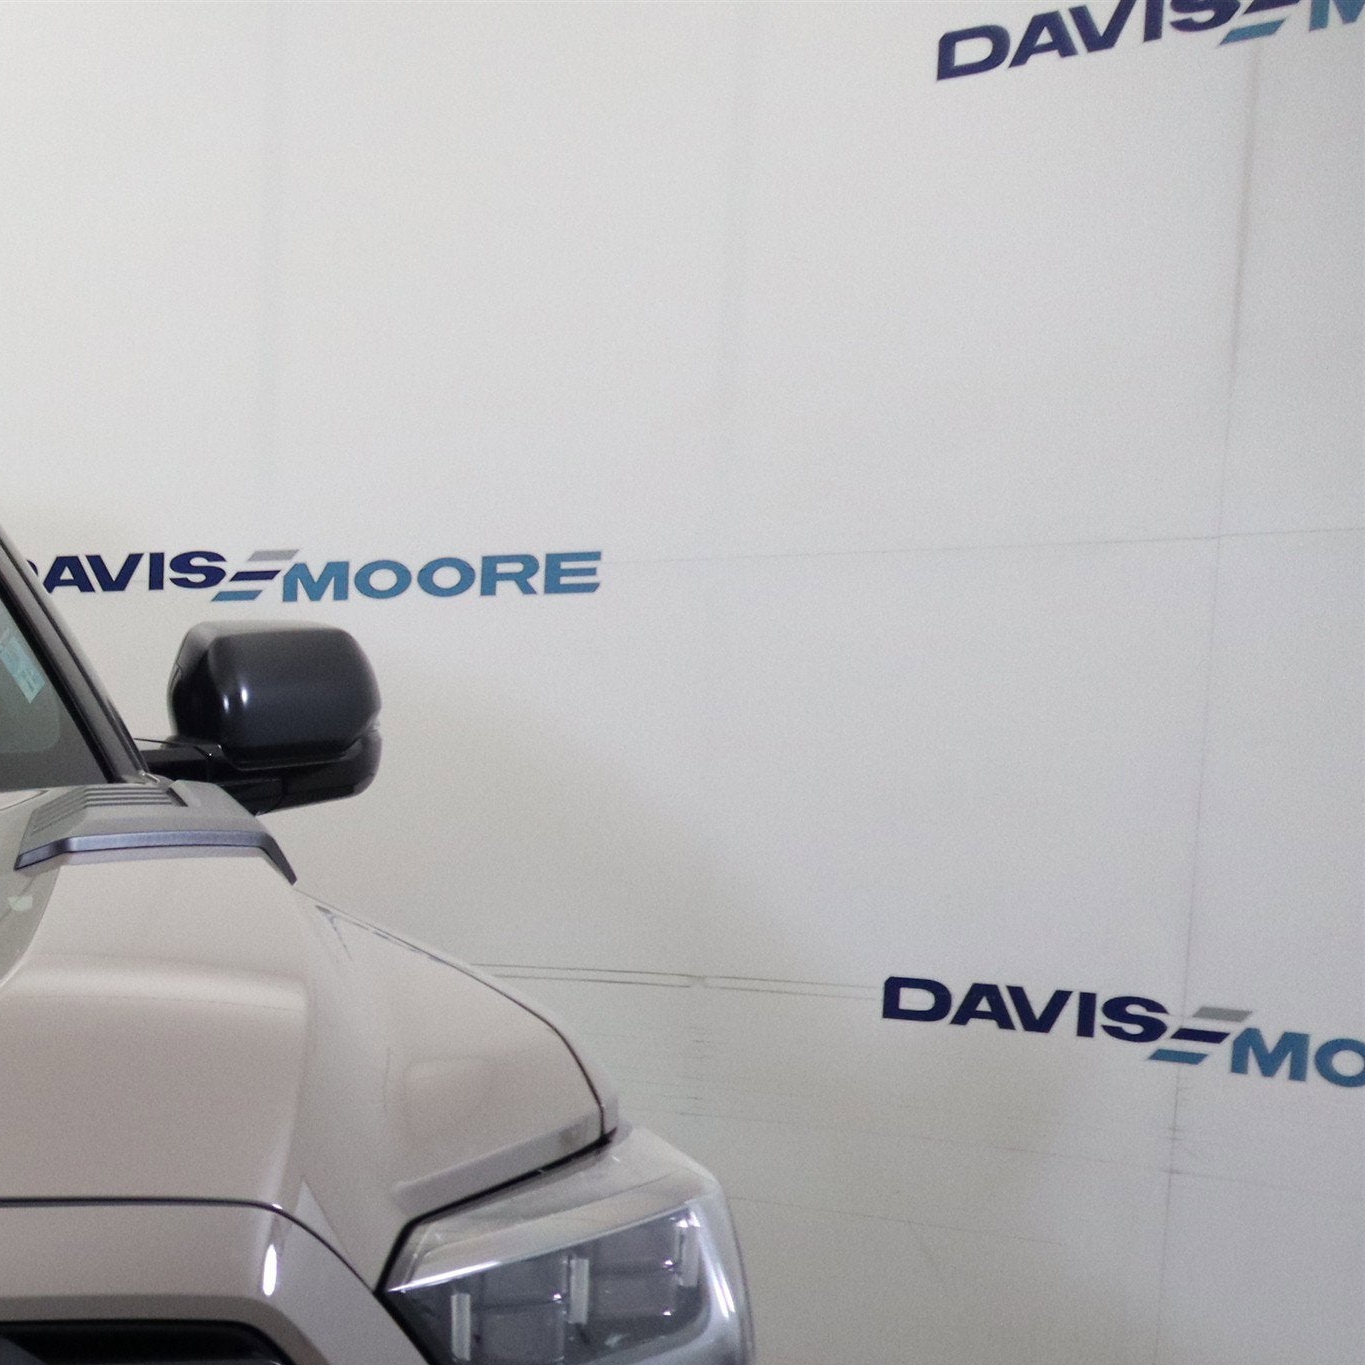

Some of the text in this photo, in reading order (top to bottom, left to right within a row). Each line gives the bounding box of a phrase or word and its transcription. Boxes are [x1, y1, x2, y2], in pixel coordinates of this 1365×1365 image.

[26, 550, 603, 603] AVIS MOORE
[882, 976, 1365, 1088] DAVIS MO
